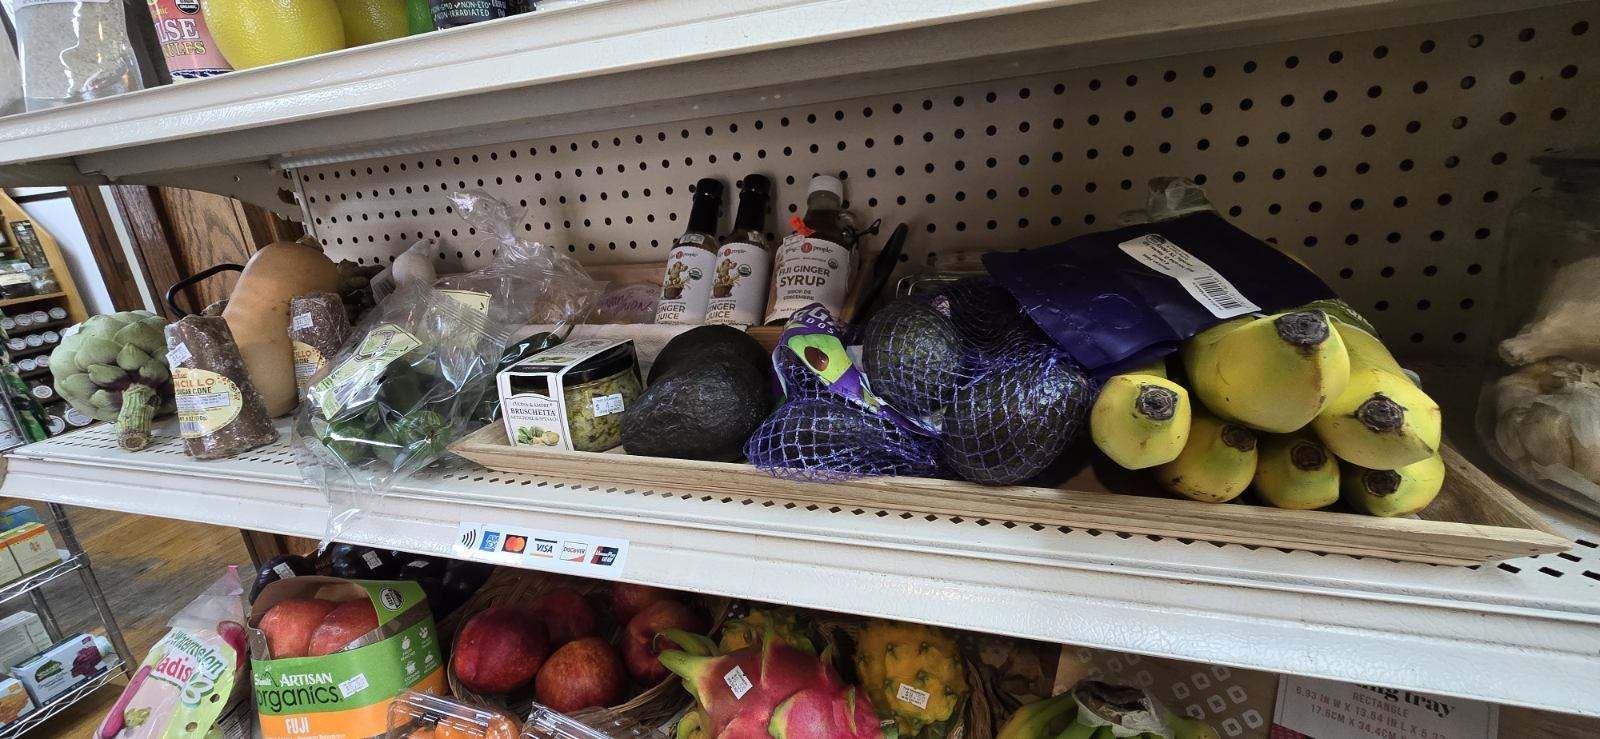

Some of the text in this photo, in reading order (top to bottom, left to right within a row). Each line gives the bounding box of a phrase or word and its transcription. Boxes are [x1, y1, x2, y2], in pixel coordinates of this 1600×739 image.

[793, 265, 830, 277] GINGER
[780, 274, 826, 287] SYRUP
[193, 386, 212, 395] CONE
[510, 407, 556, 416] BRUSCHETTA
[536, 543, 553, 553] VISA
[280, 672, 333, 687] ARTISAN
[1352, 692, 1409, 719] RECTANGLE
[285, 716, 310, 734] FUJI
